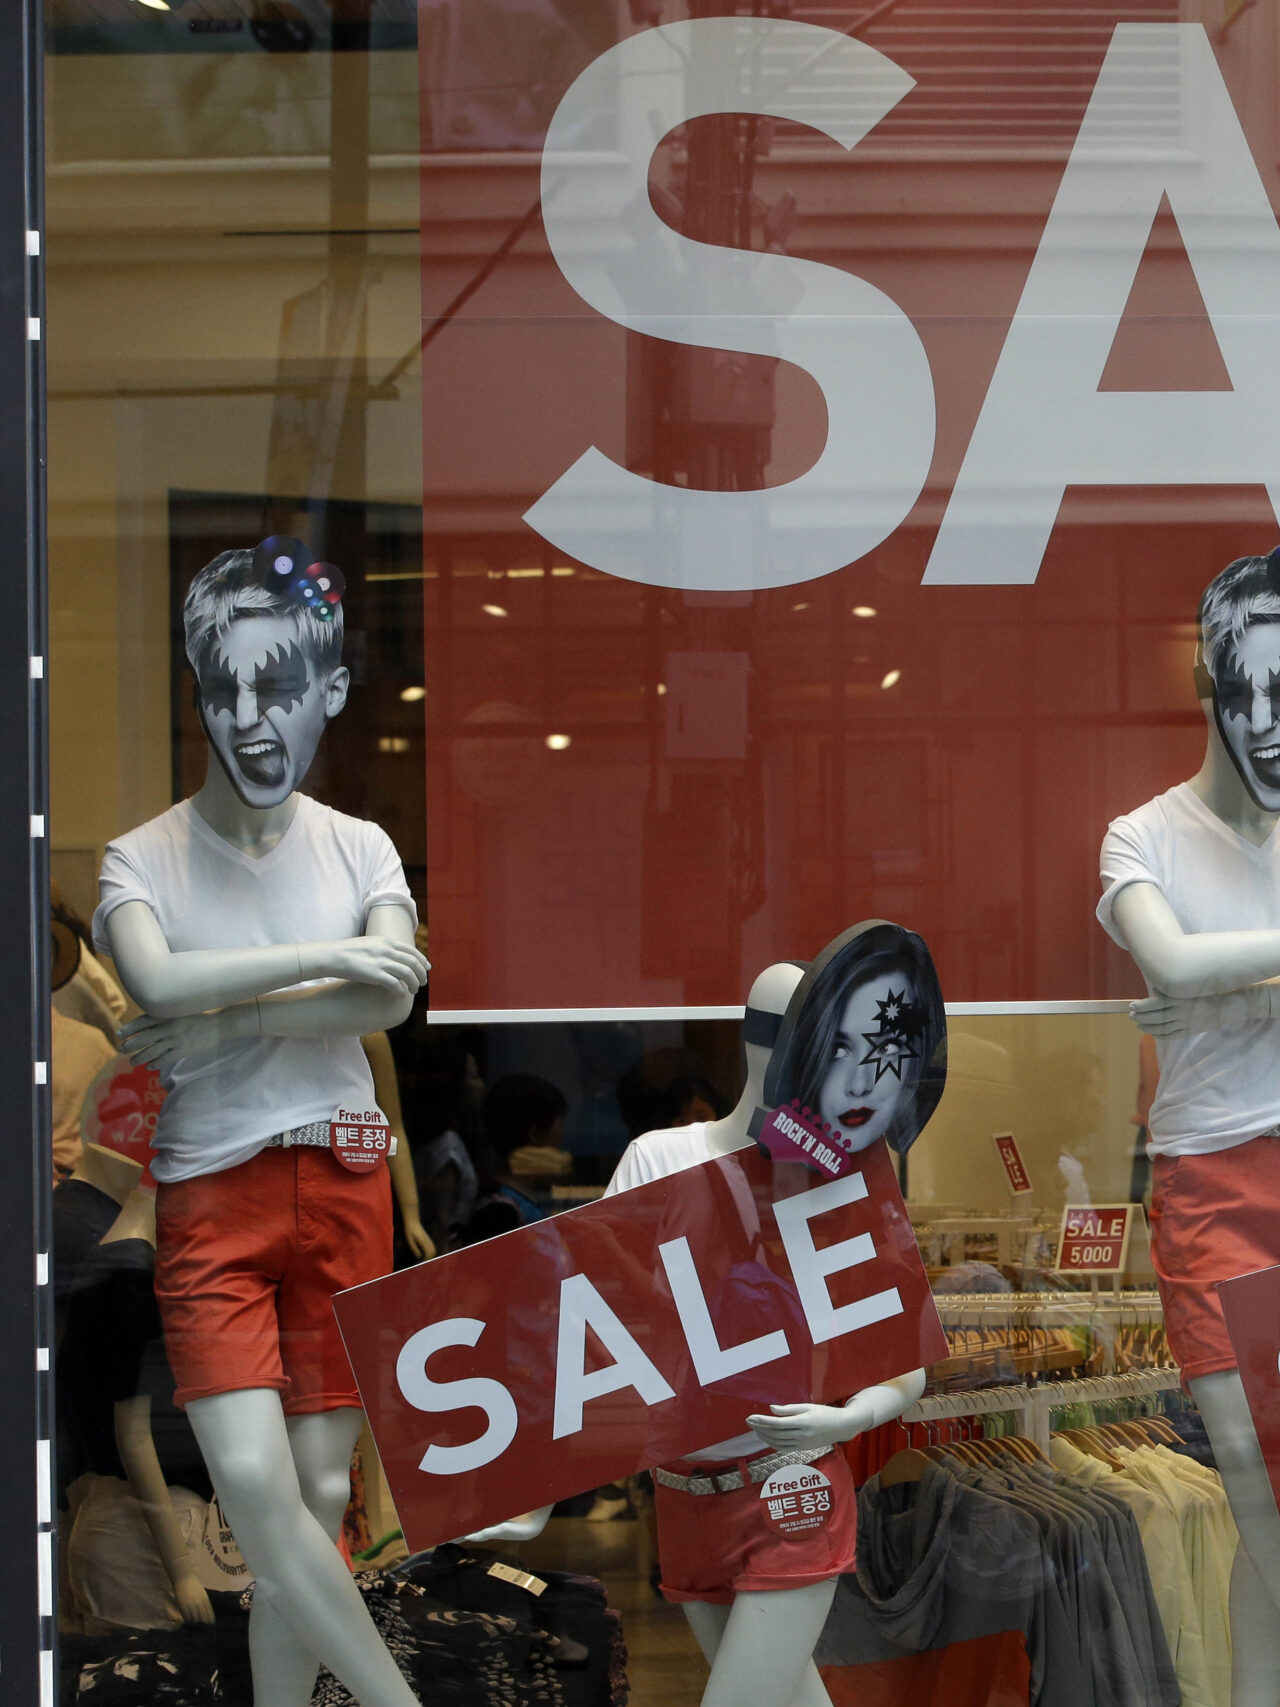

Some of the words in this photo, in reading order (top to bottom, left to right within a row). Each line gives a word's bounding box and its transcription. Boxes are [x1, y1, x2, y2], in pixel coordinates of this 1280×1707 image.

[338, 1109, 363, 1122] Free
[363, 1110, 382, 1123] Gift
[335, 1126, 360, 1147] 벨트
[361, 1128, 387, 1150] 증정
[811, 1142, 842, 1175] ROLL
[1066, 1218, 1125, 1238] SALE
[1070, 1246, 1113, 1265] 5,000
[396, 1171, 904, 1475] SALE
[768, 1480, 798, 1494] Free
[800, 1474, 822, 1488] Gift
[767, 1496, 799, 1520] 벨트
[800, 1490, 831, 1514] 증정
